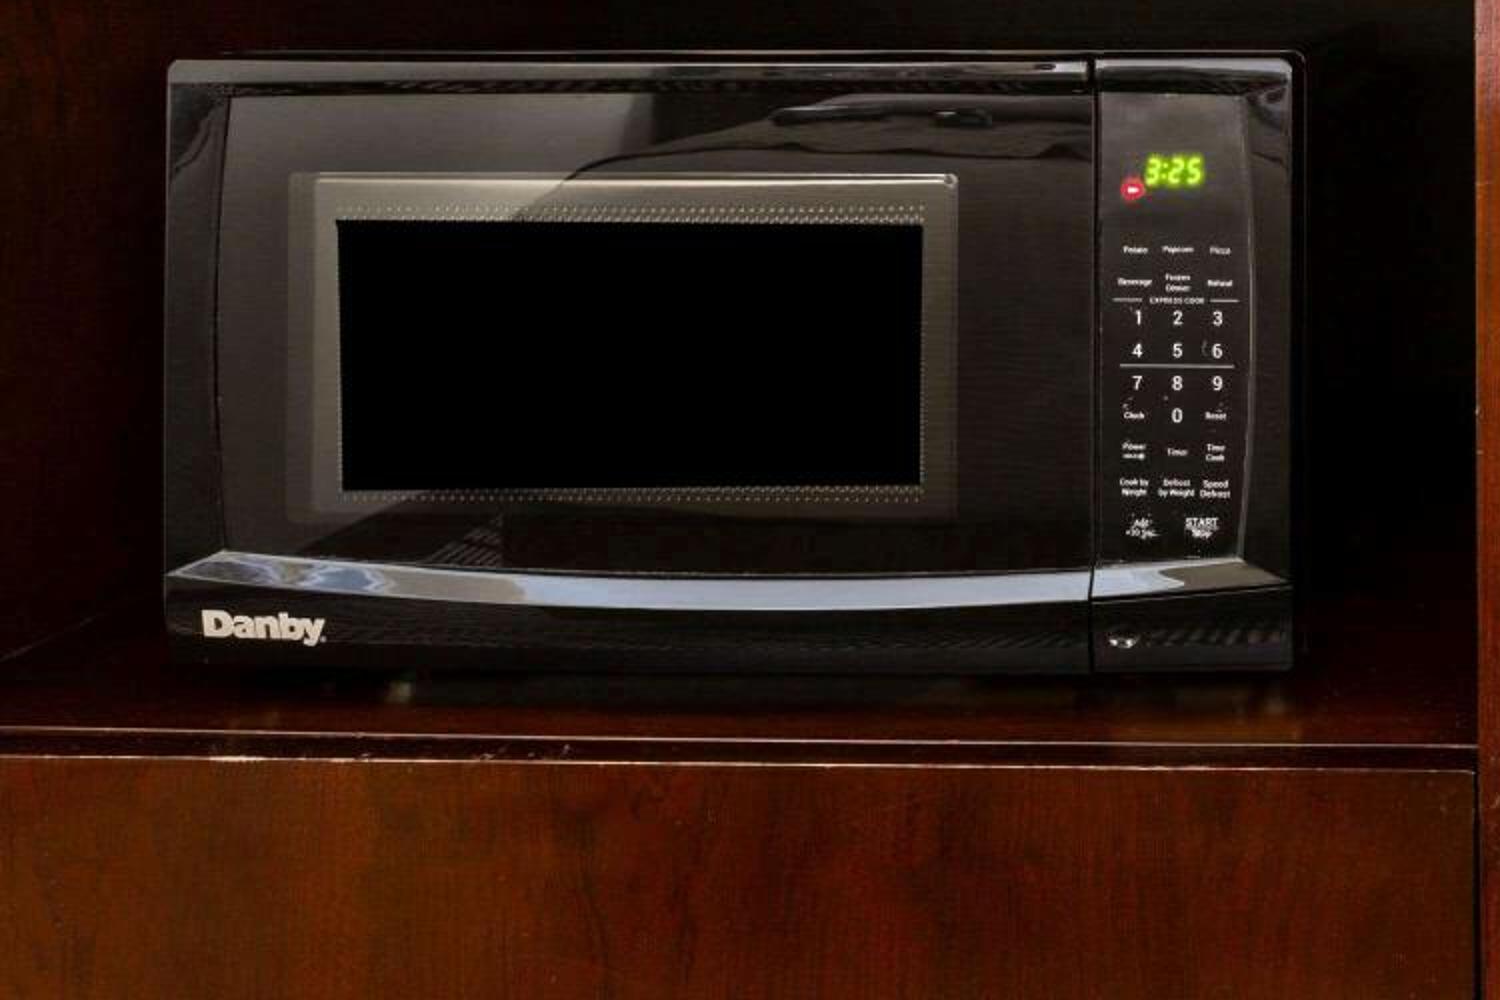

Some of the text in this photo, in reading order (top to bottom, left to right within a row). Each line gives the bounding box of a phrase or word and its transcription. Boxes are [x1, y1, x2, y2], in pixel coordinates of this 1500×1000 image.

[1144, 155, 1204, 187] 3:25
[1135, 310, 1223, 326] 1 2 3
[1131, 343, 1223, 359] 4 5 6
[1131, 375, 1223, 391] 7 8 9
[1171, 408, 1183, 423] 0
[1185, 517, 1219, 528] START
[201, 609, 325, 646] Danby
